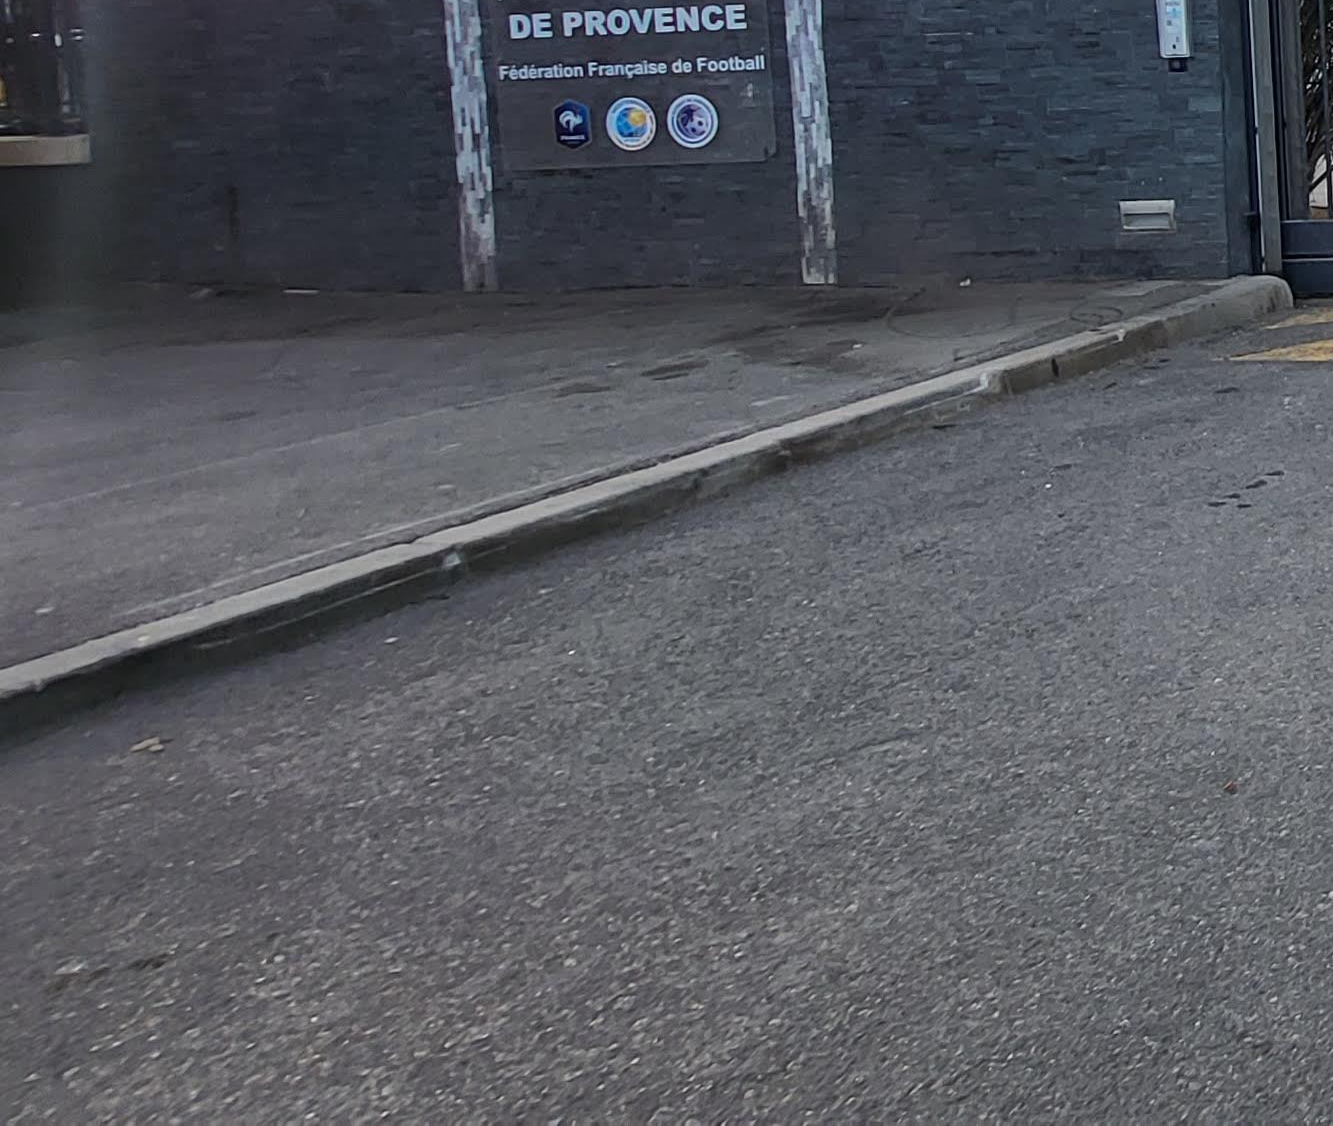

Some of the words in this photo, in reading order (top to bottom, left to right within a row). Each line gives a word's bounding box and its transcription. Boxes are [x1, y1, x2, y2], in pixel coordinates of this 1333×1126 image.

[508, 12, 553, 39] DE
[562, 4, 748, 37] PROVENCE
[498, 63, 584, 80] Fédération
[587, 61, 668, 79] Française
[671, 58, 693, 74] de
[696, 54, 765, 73] Football
